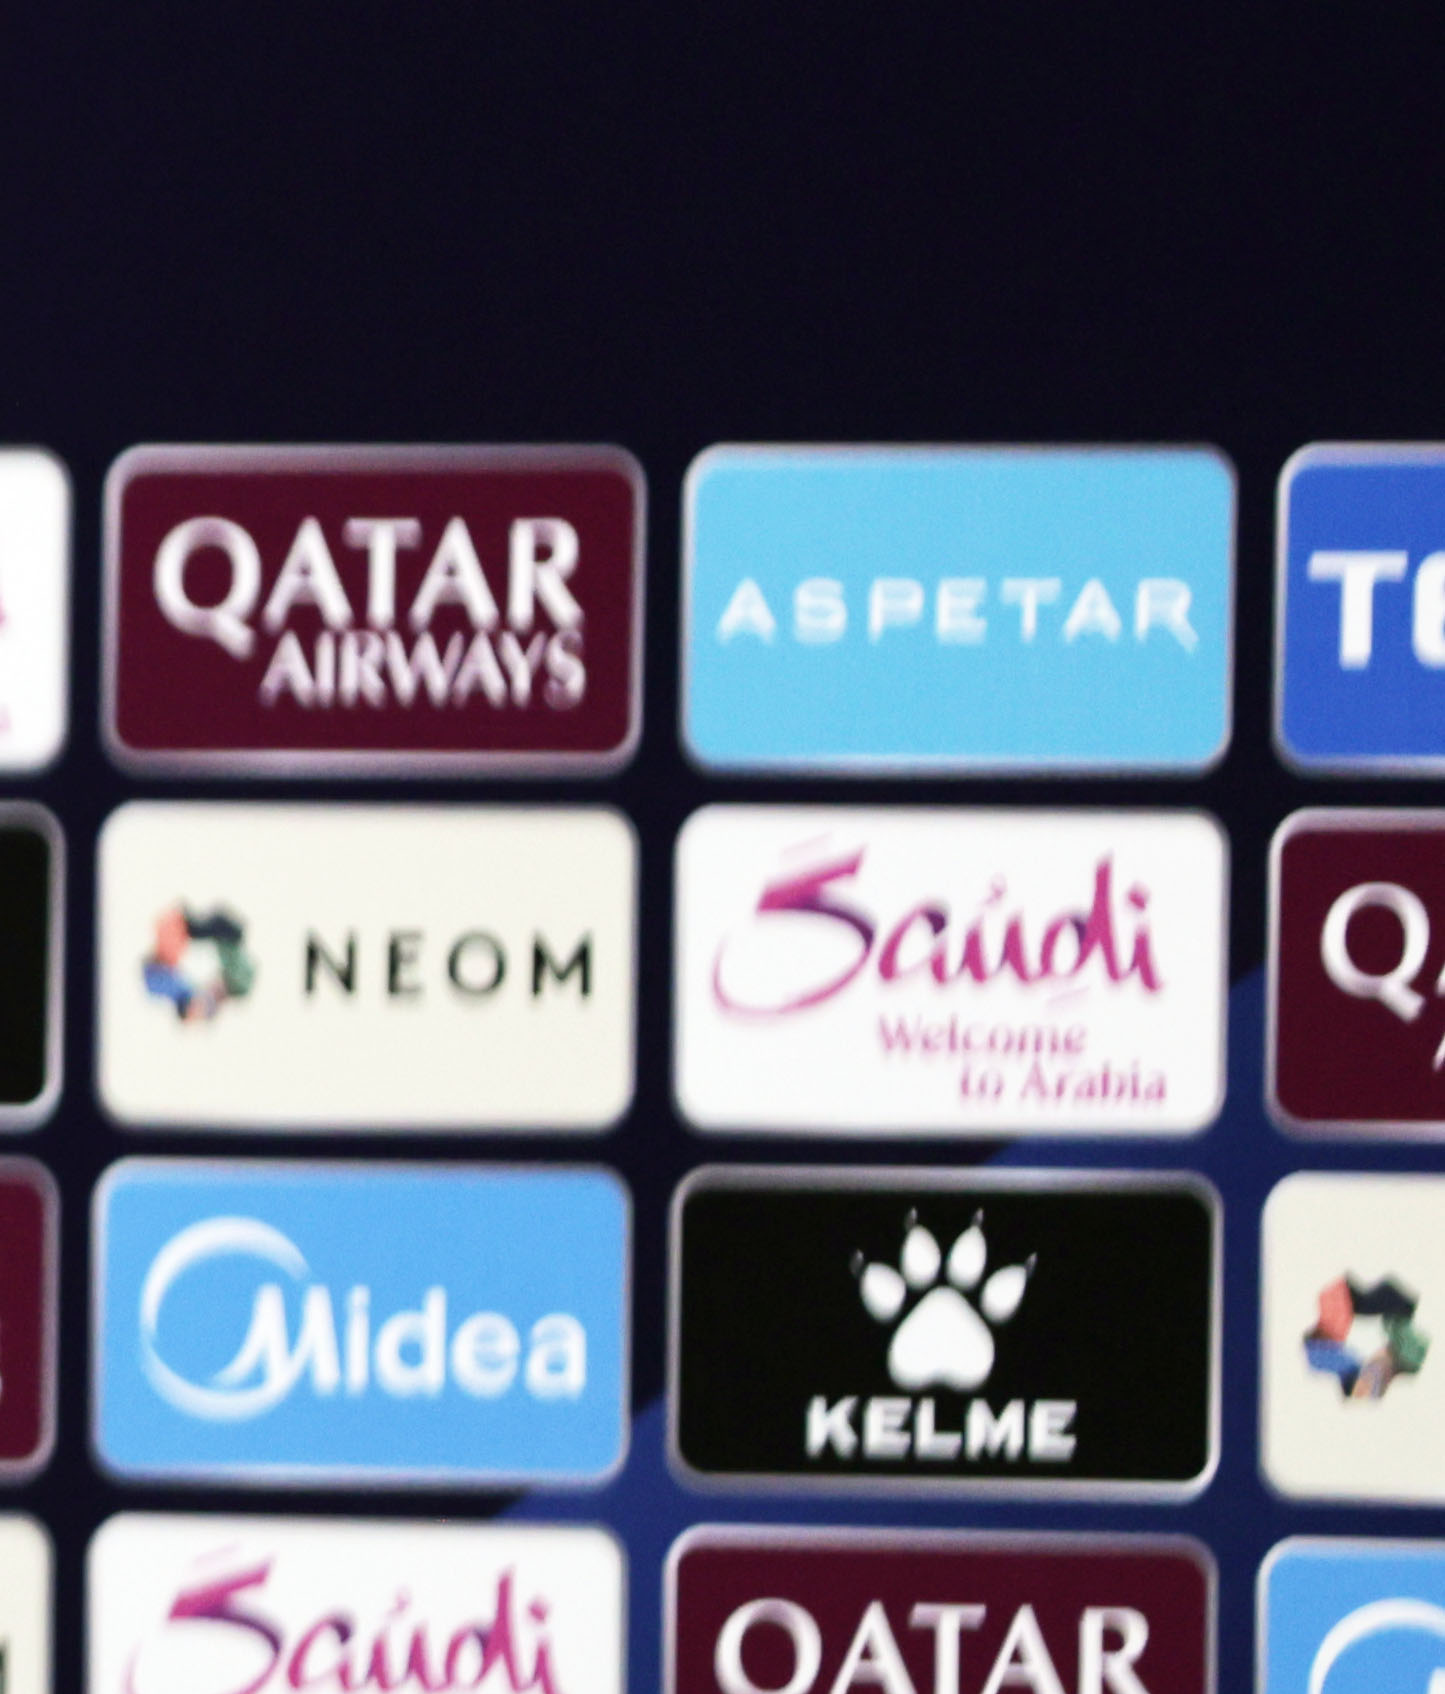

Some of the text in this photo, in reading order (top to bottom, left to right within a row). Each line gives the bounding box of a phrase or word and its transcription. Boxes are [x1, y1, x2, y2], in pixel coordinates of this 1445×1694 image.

[154, 516, 582, 660] QATAR
[717, 578, 1199, 653] ASPETAR
[261, 630, 585, 708] AIRWAYS
[304, 930, 593, 999] NEOM
[878, 1014, 1086, 1056] Welcome
[961, 1062, 1166, 1103] to Arabia
[204, 1280, 587, 1395] Midea
[806, 1397, 1076, 1461] KELME
